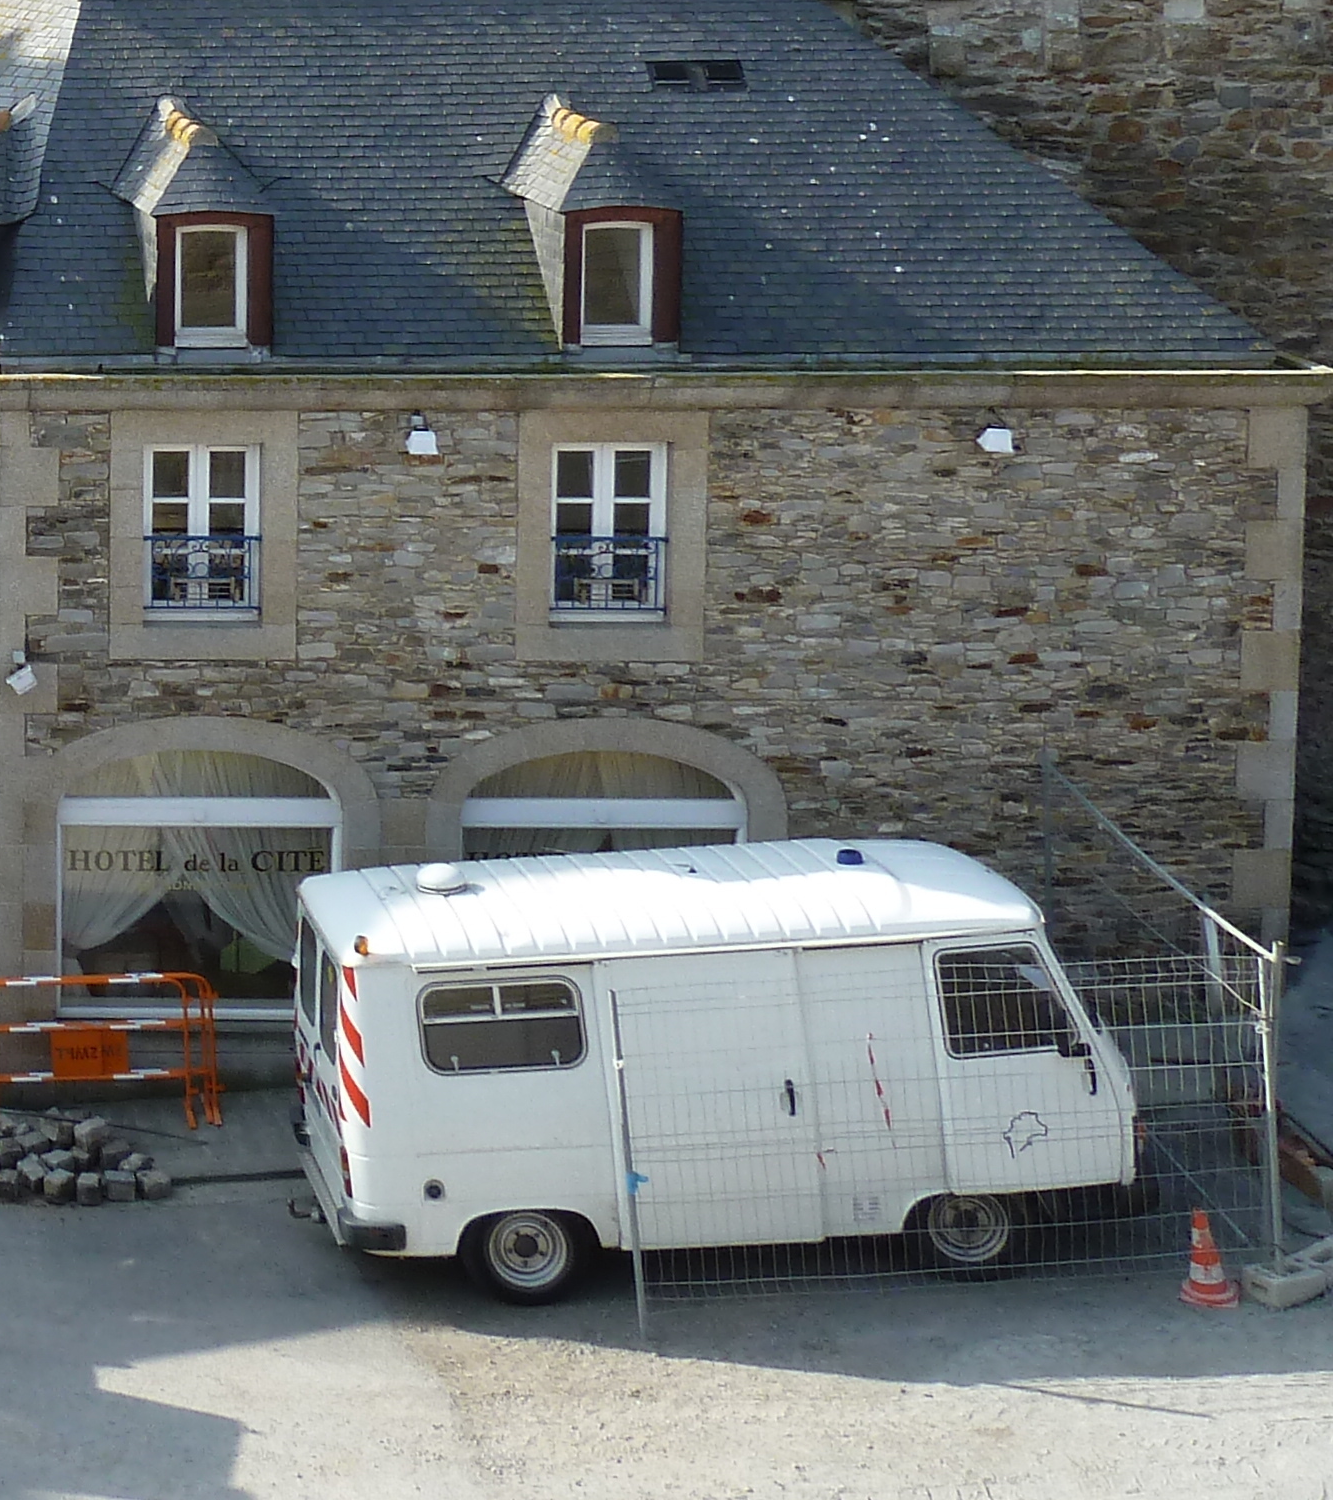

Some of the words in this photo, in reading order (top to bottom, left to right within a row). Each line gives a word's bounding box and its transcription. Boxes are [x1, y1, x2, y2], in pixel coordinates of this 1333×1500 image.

[67, 850, 169, 872] HOTEL
[184, 852, 210, 873] de
[219, 851, 239, 872] la
